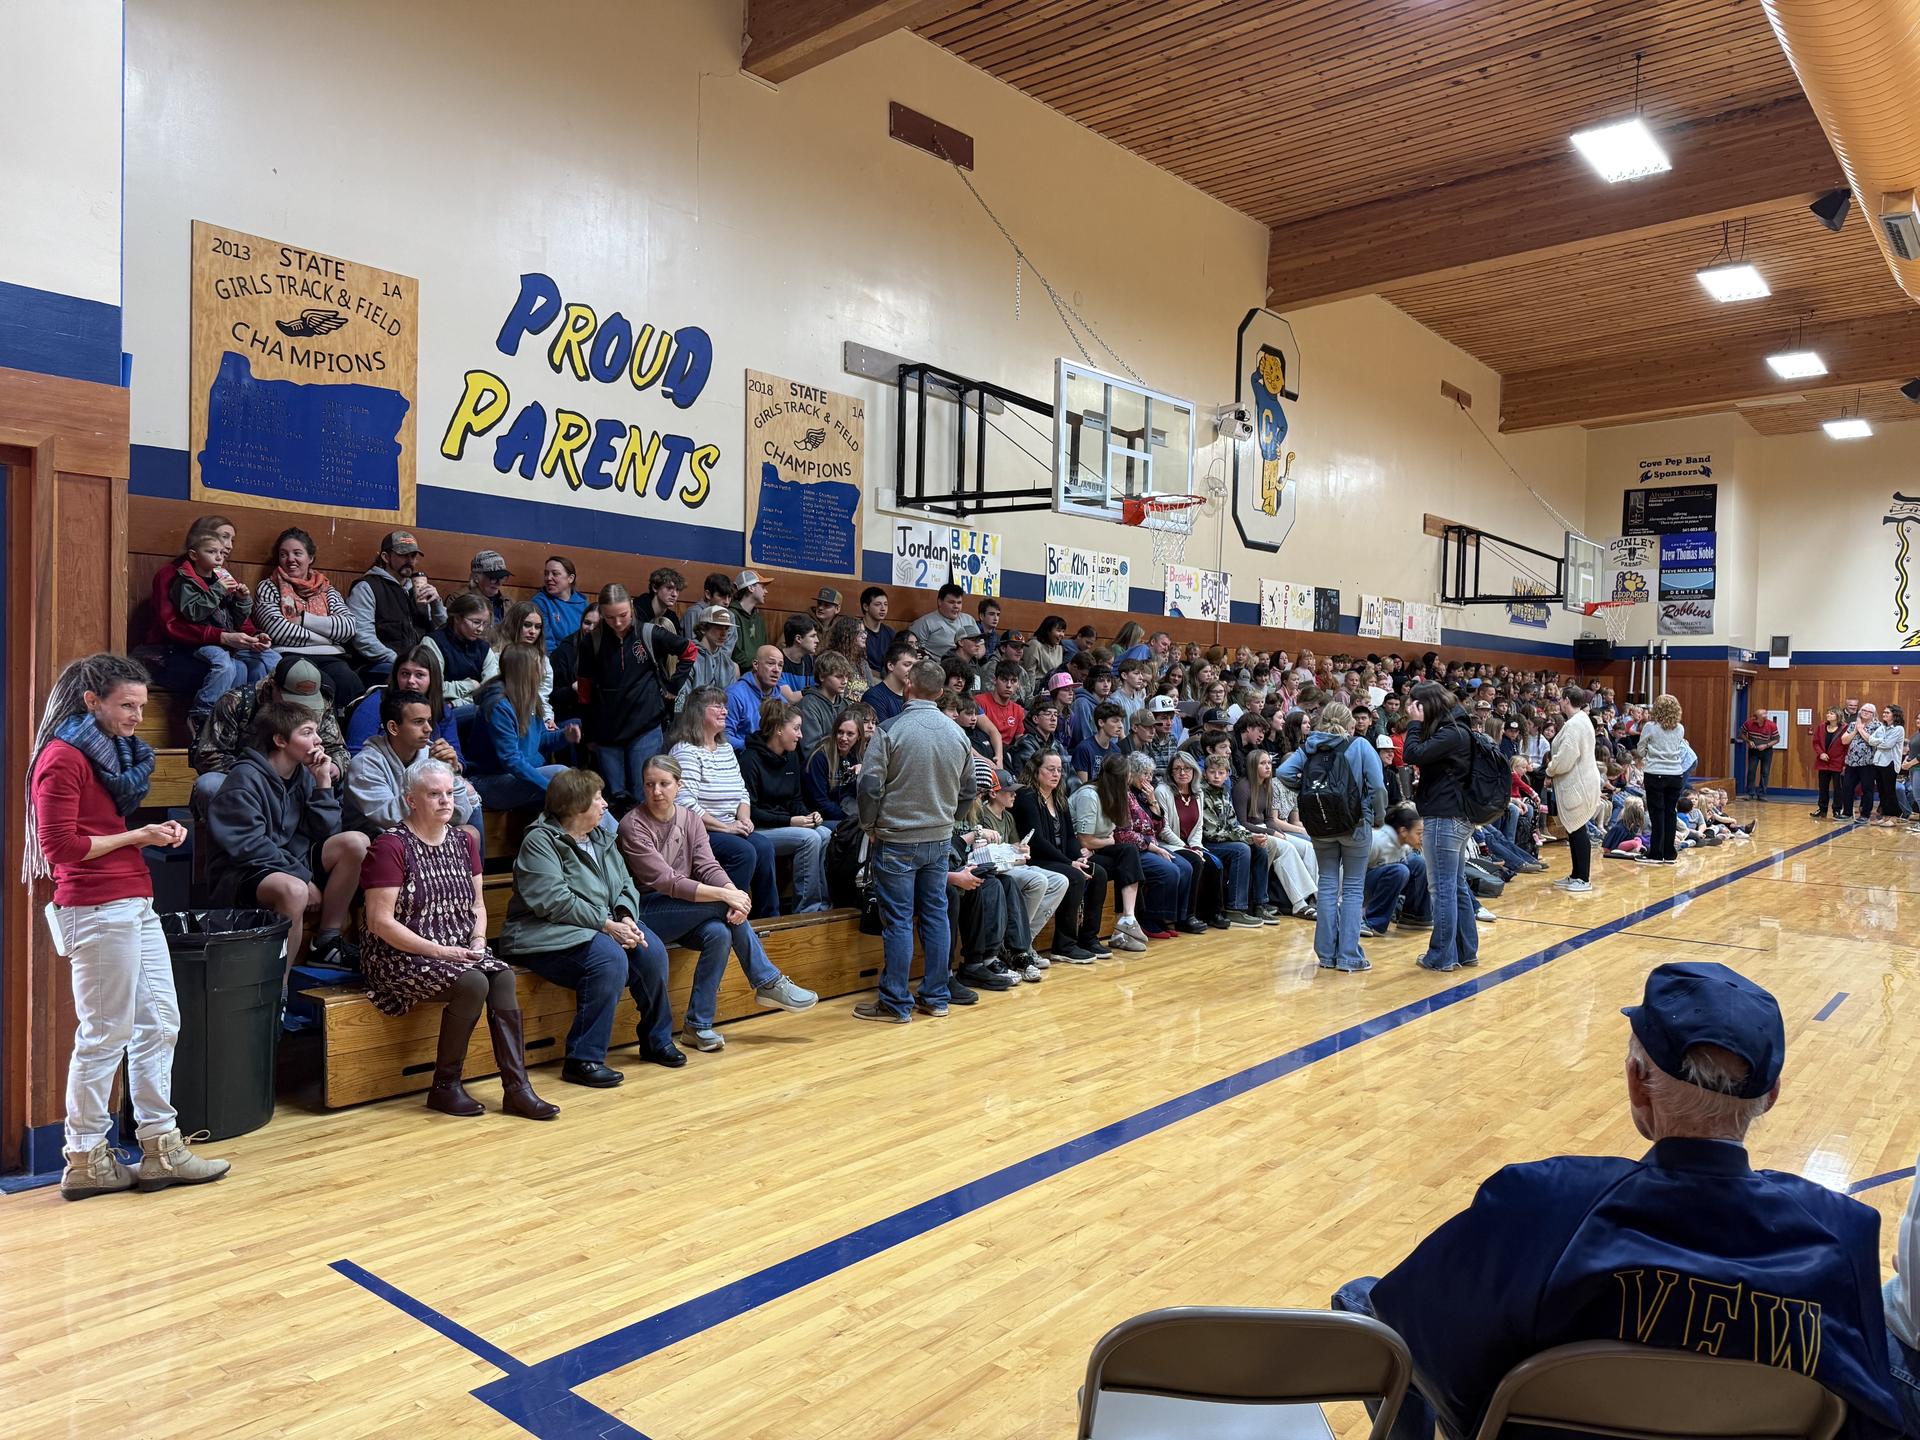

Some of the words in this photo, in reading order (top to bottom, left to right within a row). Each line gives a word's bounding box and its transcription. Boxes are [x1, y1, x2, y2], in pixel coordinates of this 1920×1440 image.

[211, 238, 251, 261] 2013
[279, 247, 346, 281] STATE
[382, 282, 403, 300] 1A
[214, 274, 273, 300] GIRLS
[276, 274, 334, 303] TRACK
[337, 288, 351, 310] &
[356, 297, 402, 337] FIELD
[231, 321, 386, 373] CHAMPIONS
[495, 272, 713, 410] PROUD
[748, 379, 774, 396] 2018
[790, 382, 828, 405] STATE
[852, 406, 865, 420] 1A
[753, 403, 783, 429] GIRLS
[784, 401, 821, 420] TRACK
[823, 412, 831, 424] &
[834, 420, 859, 452] FIELD
[440, 369, 721, 509] PARENTS
[764, 441, 852, 479] CHAMPIONS
[1639, 460, 1662, 469] Cove
[1665, 458, 1682, 466] Pep
[1686, 455, 1711, 464] Band
[1653, 469, 1698, 480] Sponsors
[896, 526, 948, 562] Jordan
[951, 529, 999, 555] BRILEY
[1610, 537, 1655, 551] CONLEY
[1662, 549, 1676, 561] Drew
[1676, 548, 1698, 560] Thomas
[1698, 546, 1714, 560] Noble
[914, 558, 928, 587] 2
[929, 560, 945, 570] Fresh
[952, 553, 968, 571] #6
[1098, 566, 1119, 576] LEOPRD
[1048, 578, 1085, 600] MURPHY
[1660, 601, 1712, 621] Robbins
[1613, 1269, 1822, 1377] VFW
